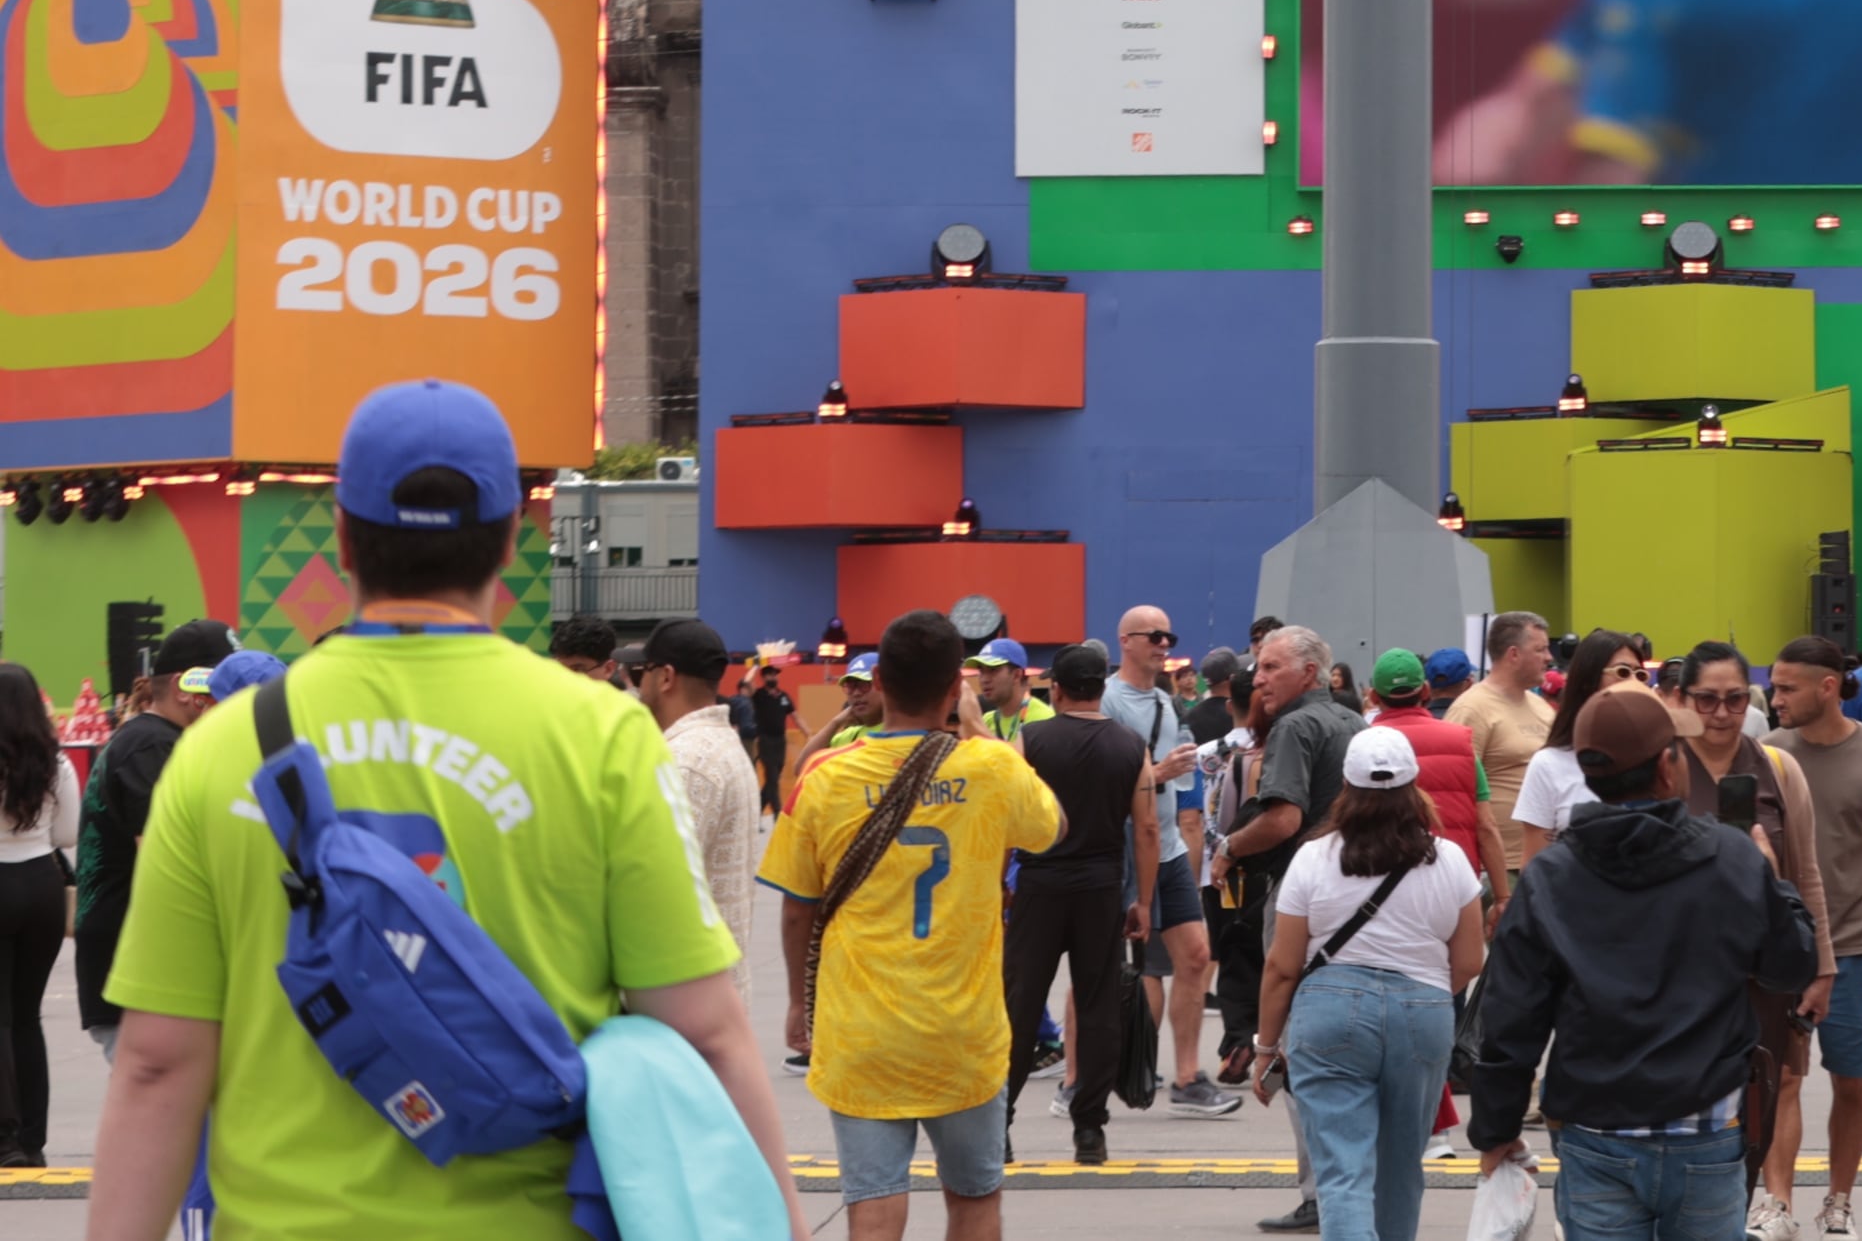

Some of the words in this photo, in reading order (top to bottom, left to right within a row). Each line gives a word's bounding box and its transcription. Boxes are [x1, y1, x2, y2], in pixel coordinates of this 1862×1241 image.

[365, 51, 489, 108] FIFA
[277, 177, 459, 229] WORLD
[466, 187, 562, 234] CUP
[275, 237, 562, 321] 2026
[229, 719, 535, 834] UNTEER
[897, 826, 950, 940] 7
